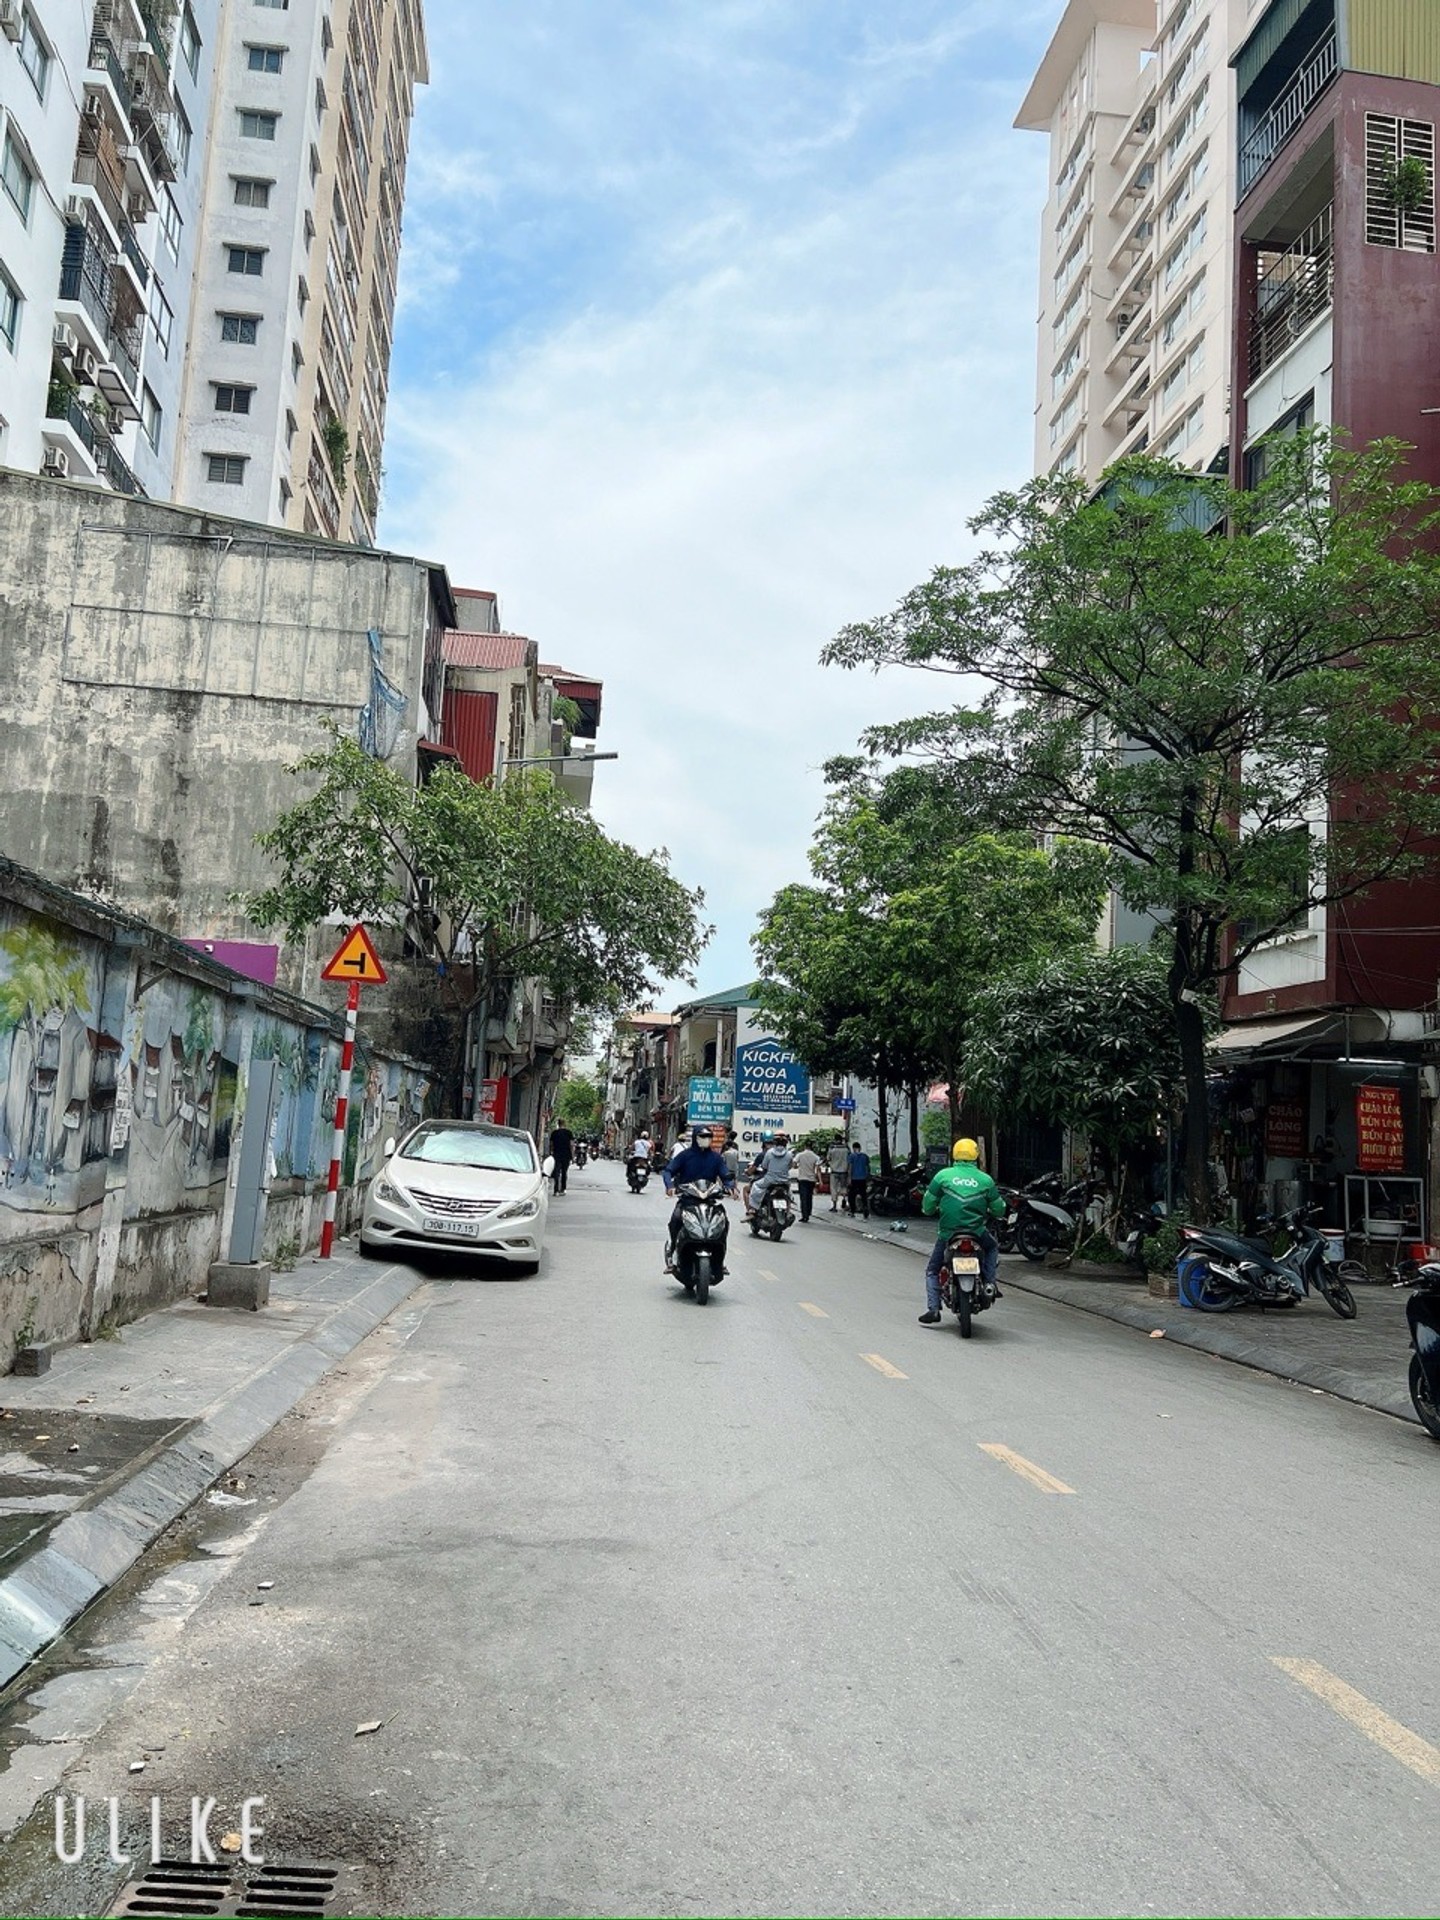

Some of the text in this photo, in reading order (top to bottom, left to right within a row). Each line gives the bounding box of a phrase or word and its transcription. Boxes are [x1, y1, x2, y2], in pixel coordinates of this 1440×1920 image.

[743, 1066, 787, 1079] YOGA
[741, 1081, 797, 1095] ZUMBA
[743, 1115, 761, 1126] TÒA
[763, 1117, 785, 1128] NHÀ
[1268, 1118, 1302, 1133] LÒNG
[952, 1178, 979, 1188] Grab
